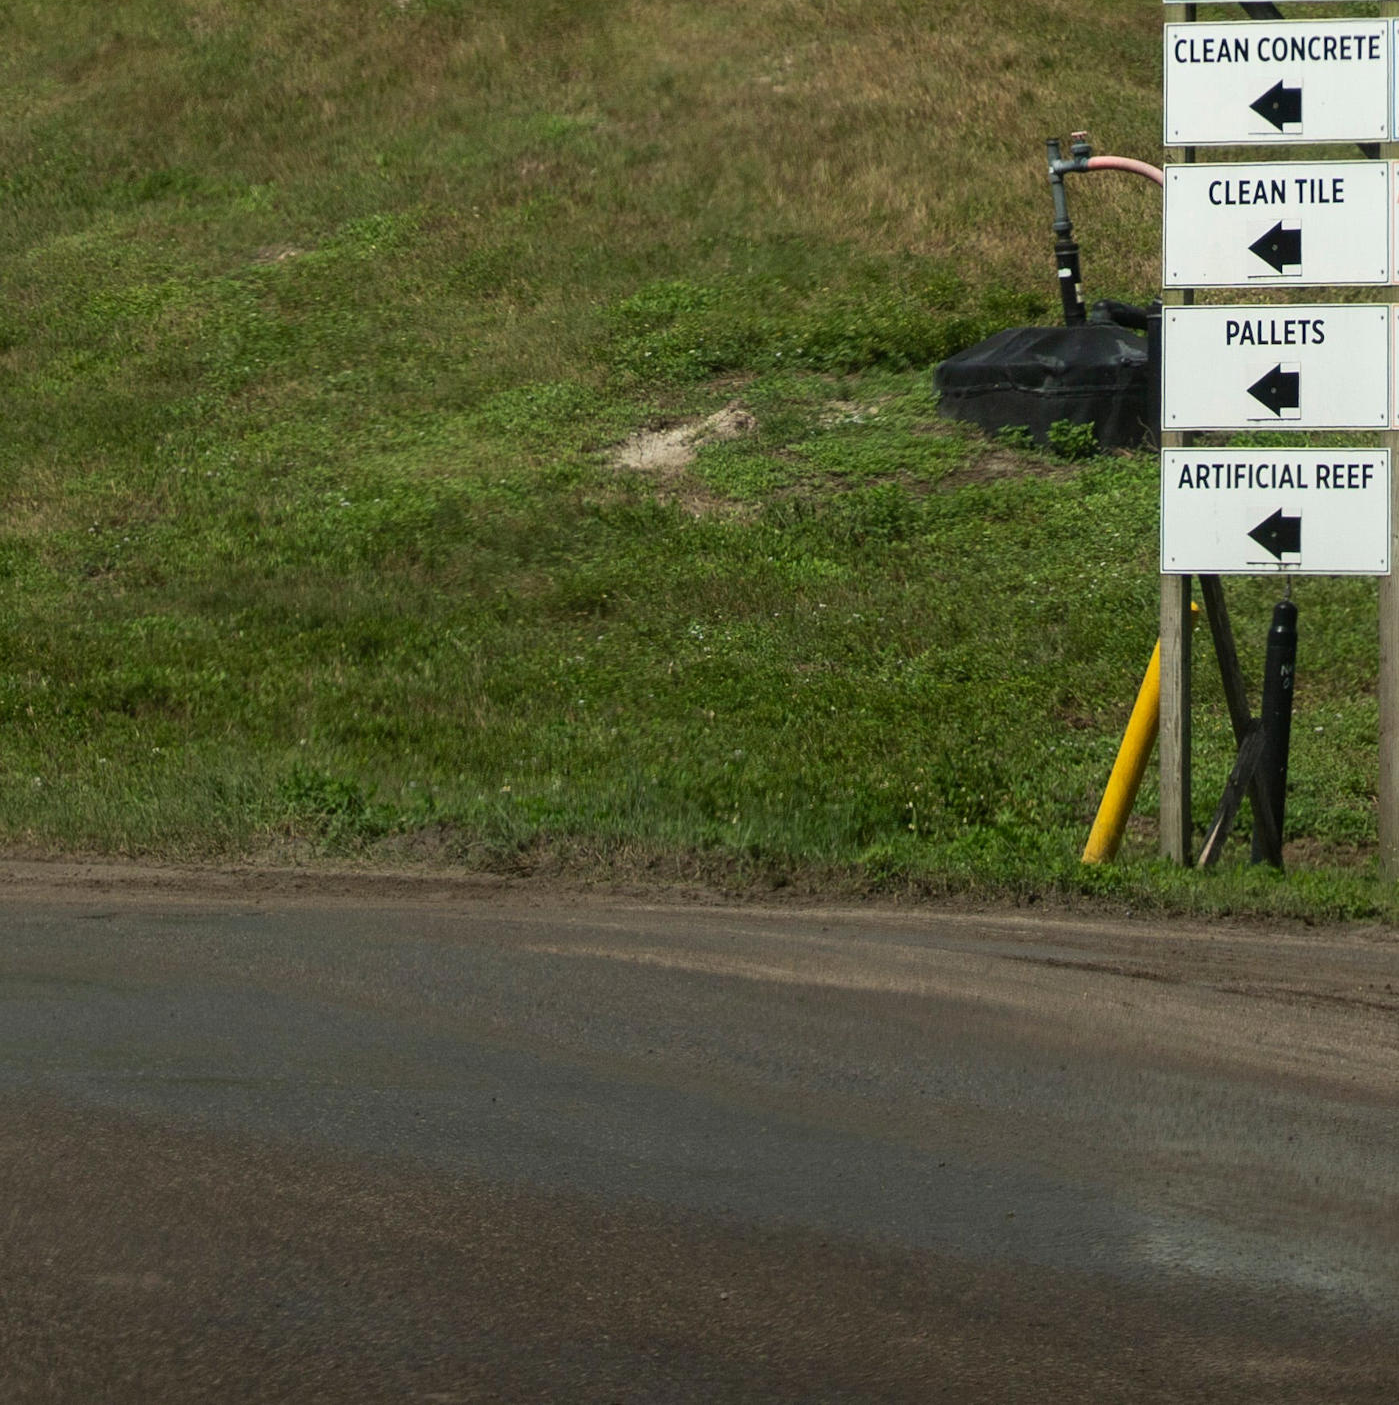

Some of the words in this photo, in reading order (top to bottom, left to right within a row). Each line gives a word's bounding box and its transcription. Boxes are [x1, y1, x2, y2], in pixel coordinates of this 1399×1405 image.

[1174, 37, 1249, 64] CLEAN
[1257, 35, 1381, 62] CONCRETE
[1208, 179, 1287, 206] CLEAN
[1294, 177, 1345, 205] TILE
[1225, 319, 1326, 347] PALLETS
[1177, 463, 1308, 491] ARTIFICIAL
[1315, 463, 1374, 491] REEF
